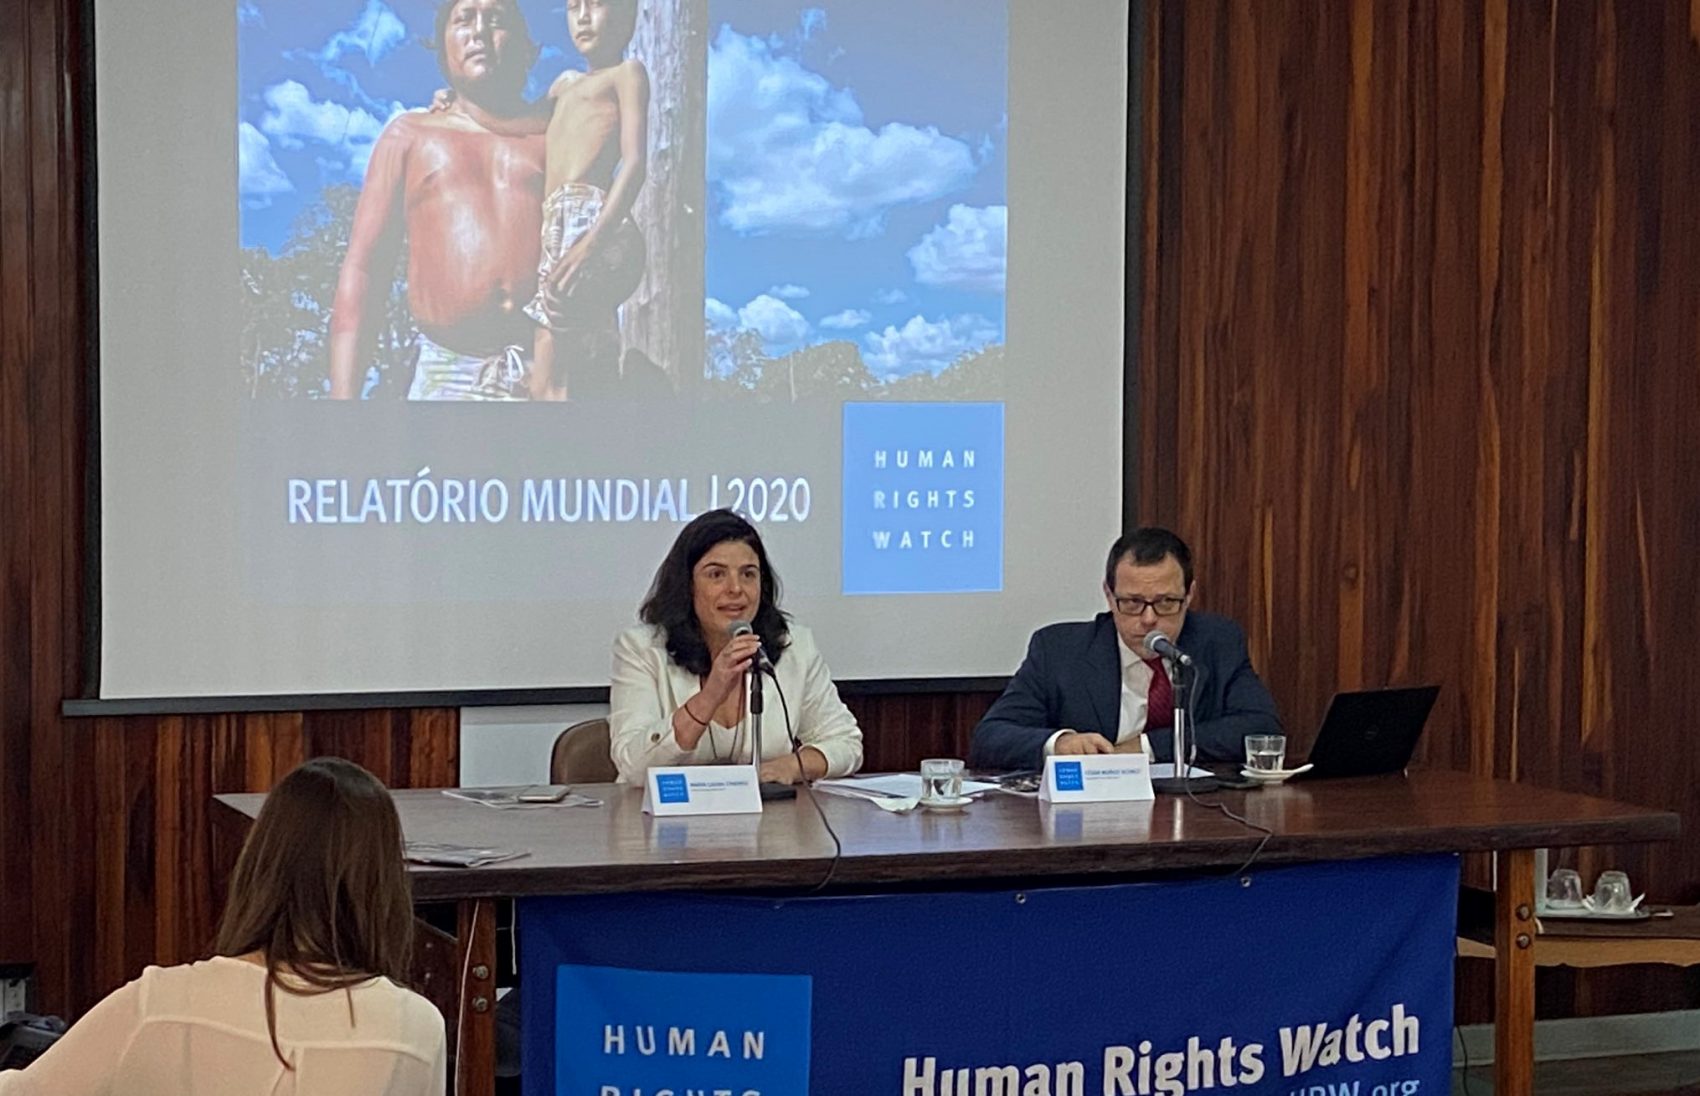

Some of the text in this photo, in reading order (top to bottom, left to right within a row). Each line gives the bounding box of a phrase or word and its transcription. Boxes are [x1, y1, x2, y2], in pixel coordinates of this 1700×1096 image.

[874, 450, 975, 468] HUMAN
[288, 467, 508, 523] RELATÓRIO
[522, 478, 699, 522] MUNDIAL
[727, 477, 811, 522] 2020
[873, 490, 975, 508] RIGHTS
[873, 530, 974, 549] WATCH
[604, 1024, 765, 1060] HUMAN
[903, 1003, 1419, 1096] Human Rights Watch
